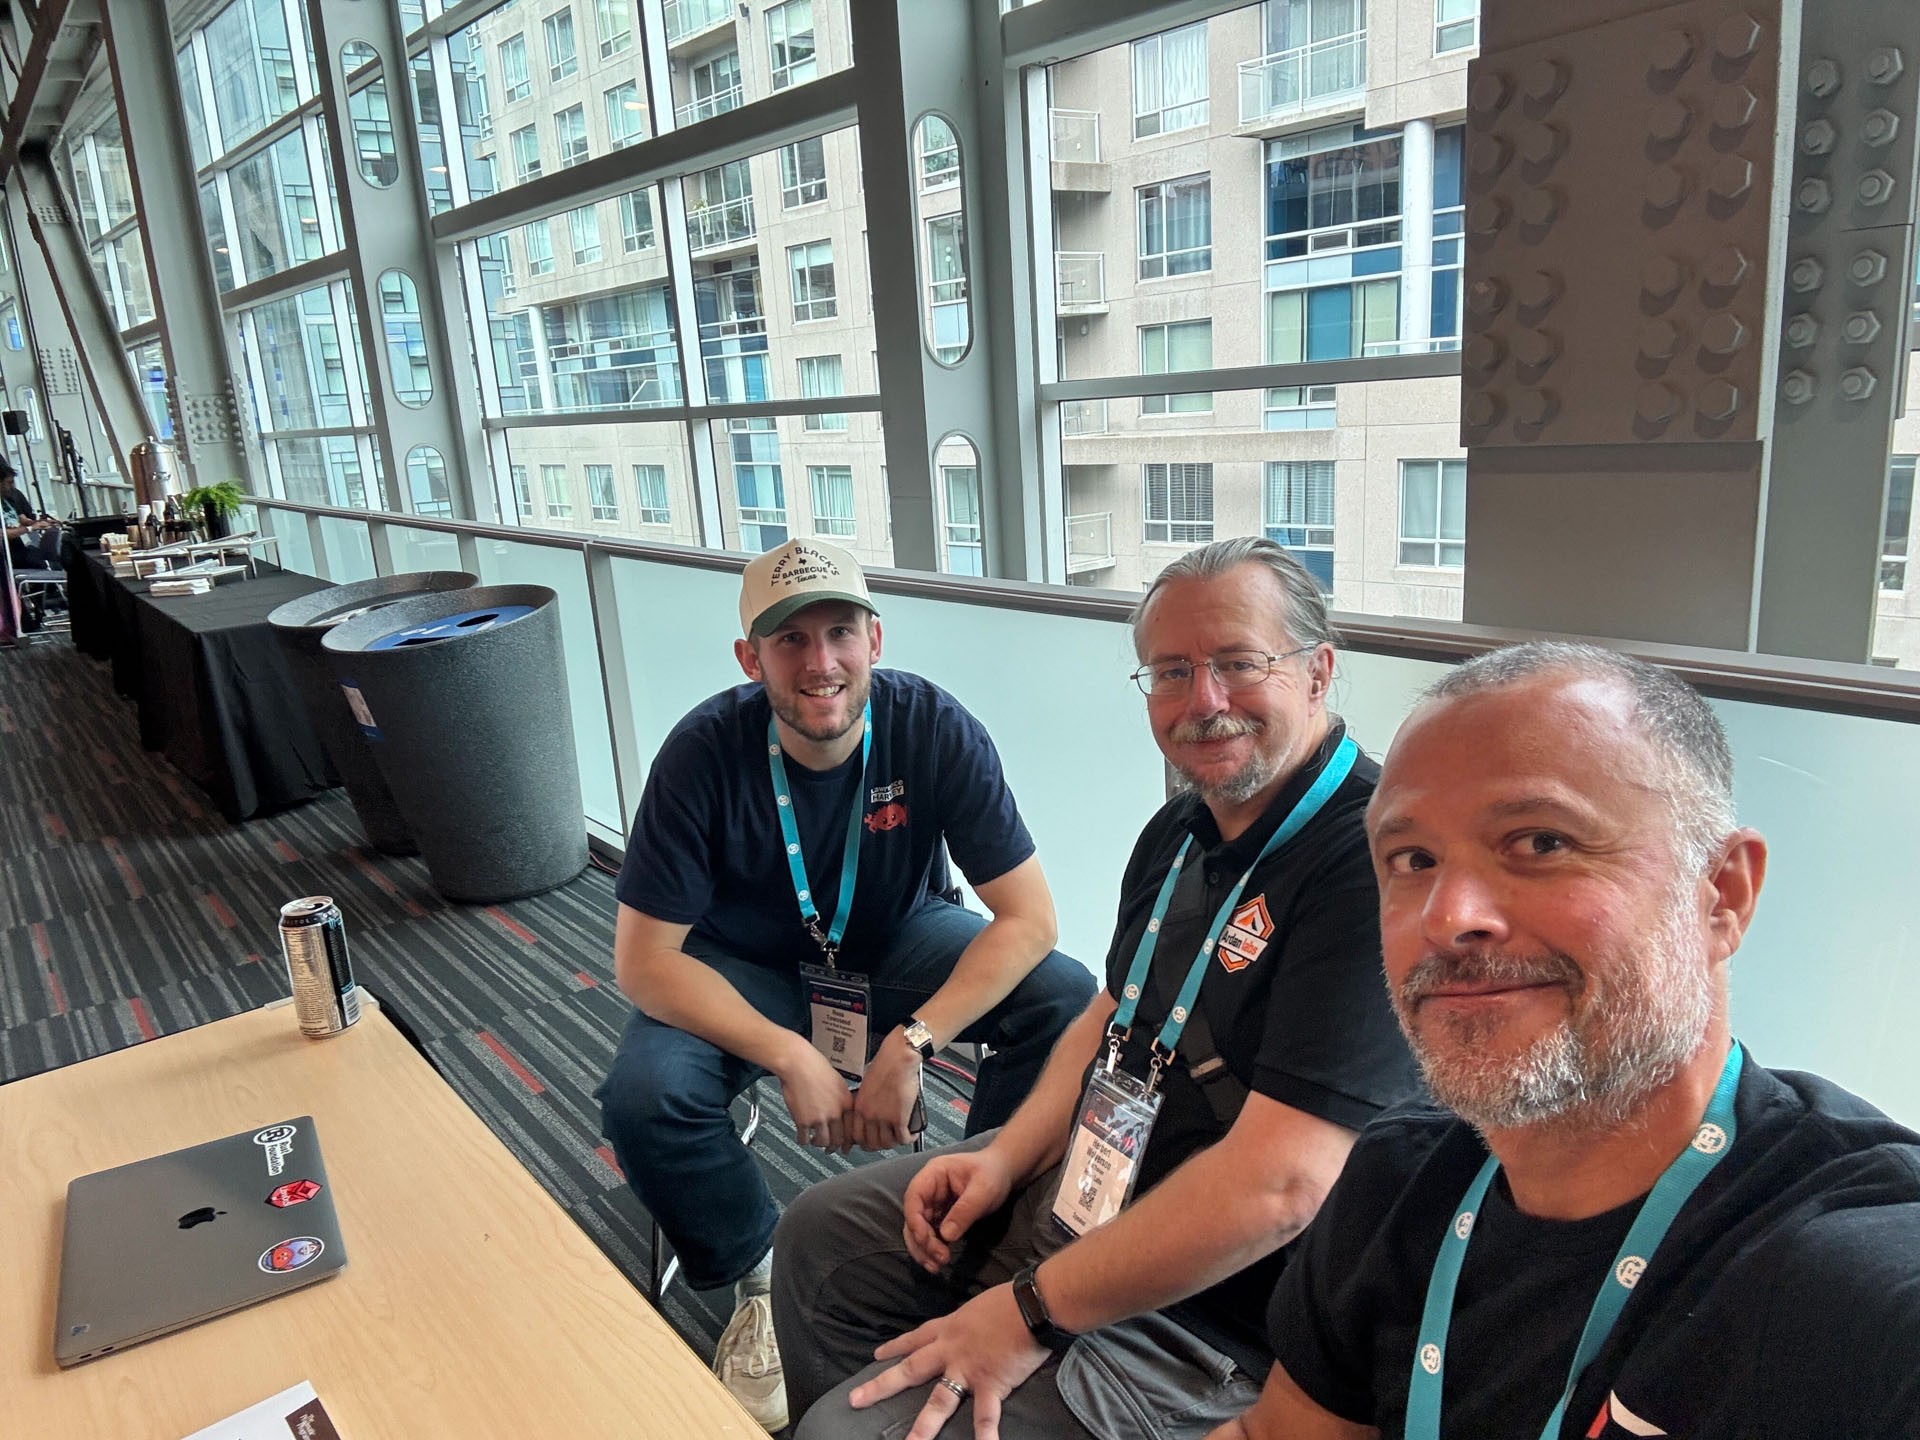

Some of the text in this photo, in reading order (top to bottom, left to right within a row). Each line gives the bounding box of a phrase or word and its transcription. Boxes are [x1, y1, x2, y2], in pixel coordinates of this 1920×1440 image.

[771, 546, 840, 587] TERRY BLACK'S
[782, 566, 828, 579] BARBECUE
[795, 574, 817, 583] Texas
[1221, 930, 1258, 955] Ardan labs
[279, 1141, 289, 1154] Rust
[267, 1144, 281, 1174] Foundation
